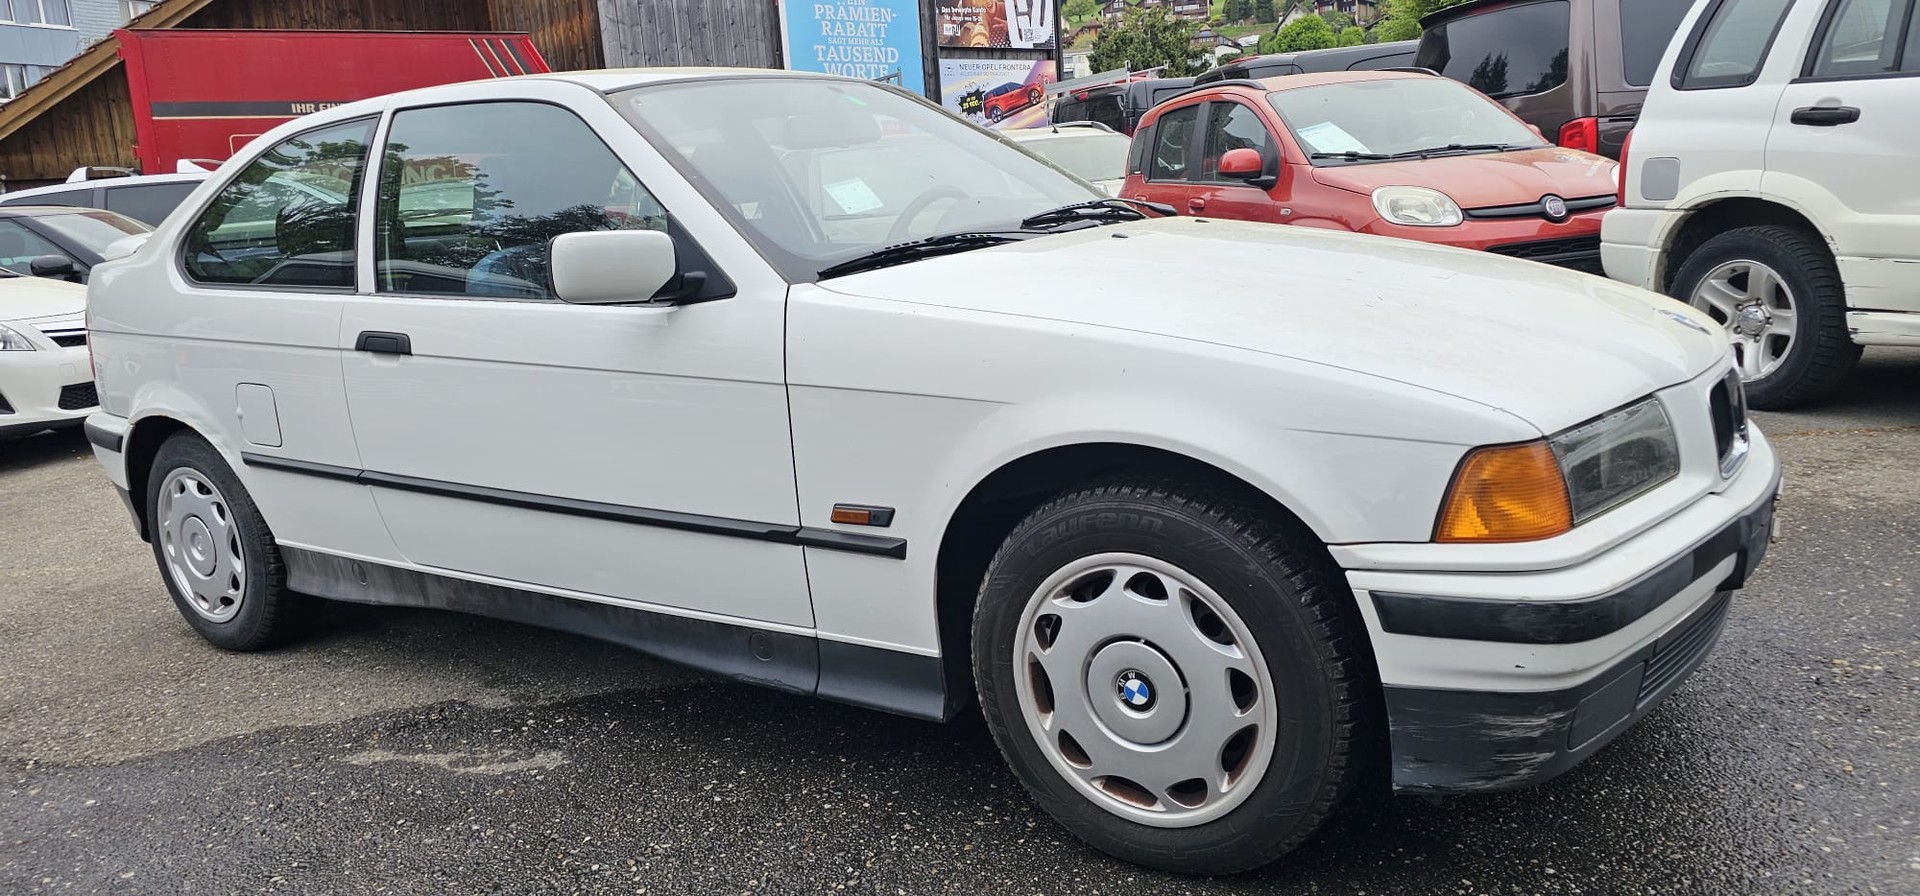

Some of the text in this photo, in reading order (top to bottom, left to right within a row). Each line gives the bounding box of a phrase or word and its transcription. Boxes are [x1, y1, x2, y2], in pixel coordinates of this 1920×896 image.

[821, 20, 888, 38] RABATT
[828, 37, 884, 46] SAGT MEHR ALS
[814, 44, 899, 63] TAUSEND
[823, 62, 889, 80] WORTE
[959, 63, 1031, 71] NEUER OPEL FRONTERA
[291, 103, 316, 114] IHR
[1118, 672, 1136, 700] BMW
